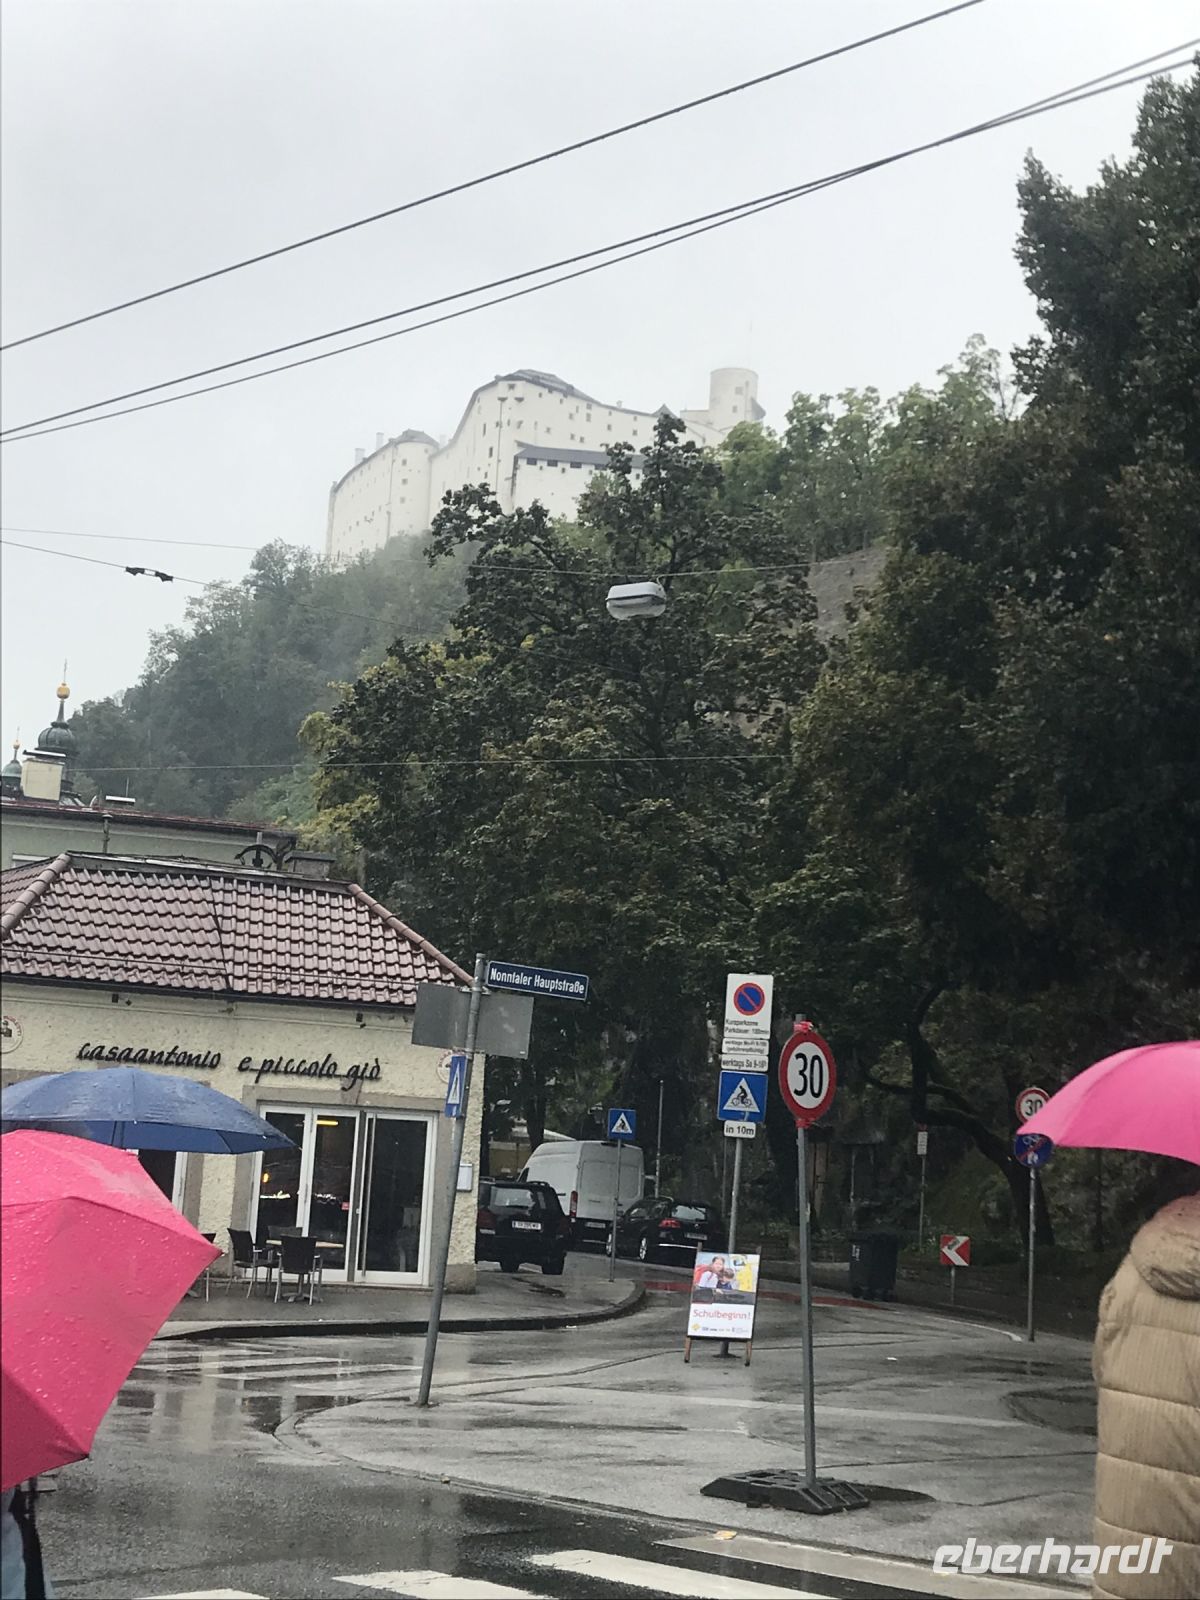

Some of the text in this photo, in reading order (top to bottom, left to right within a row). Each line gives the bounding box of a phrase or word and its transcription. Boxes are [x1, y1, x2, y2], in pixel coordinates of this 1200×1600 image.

[490, 968, 585, 994] Nonntaler Hauptstraße
[254, 1053, 339, 1085] piccolo
[793, 1052, 824, 1099] 30
[725, 1124, 755, 1136] in 10m
[693, 1309, 752, 1321] Schulbeginn!
